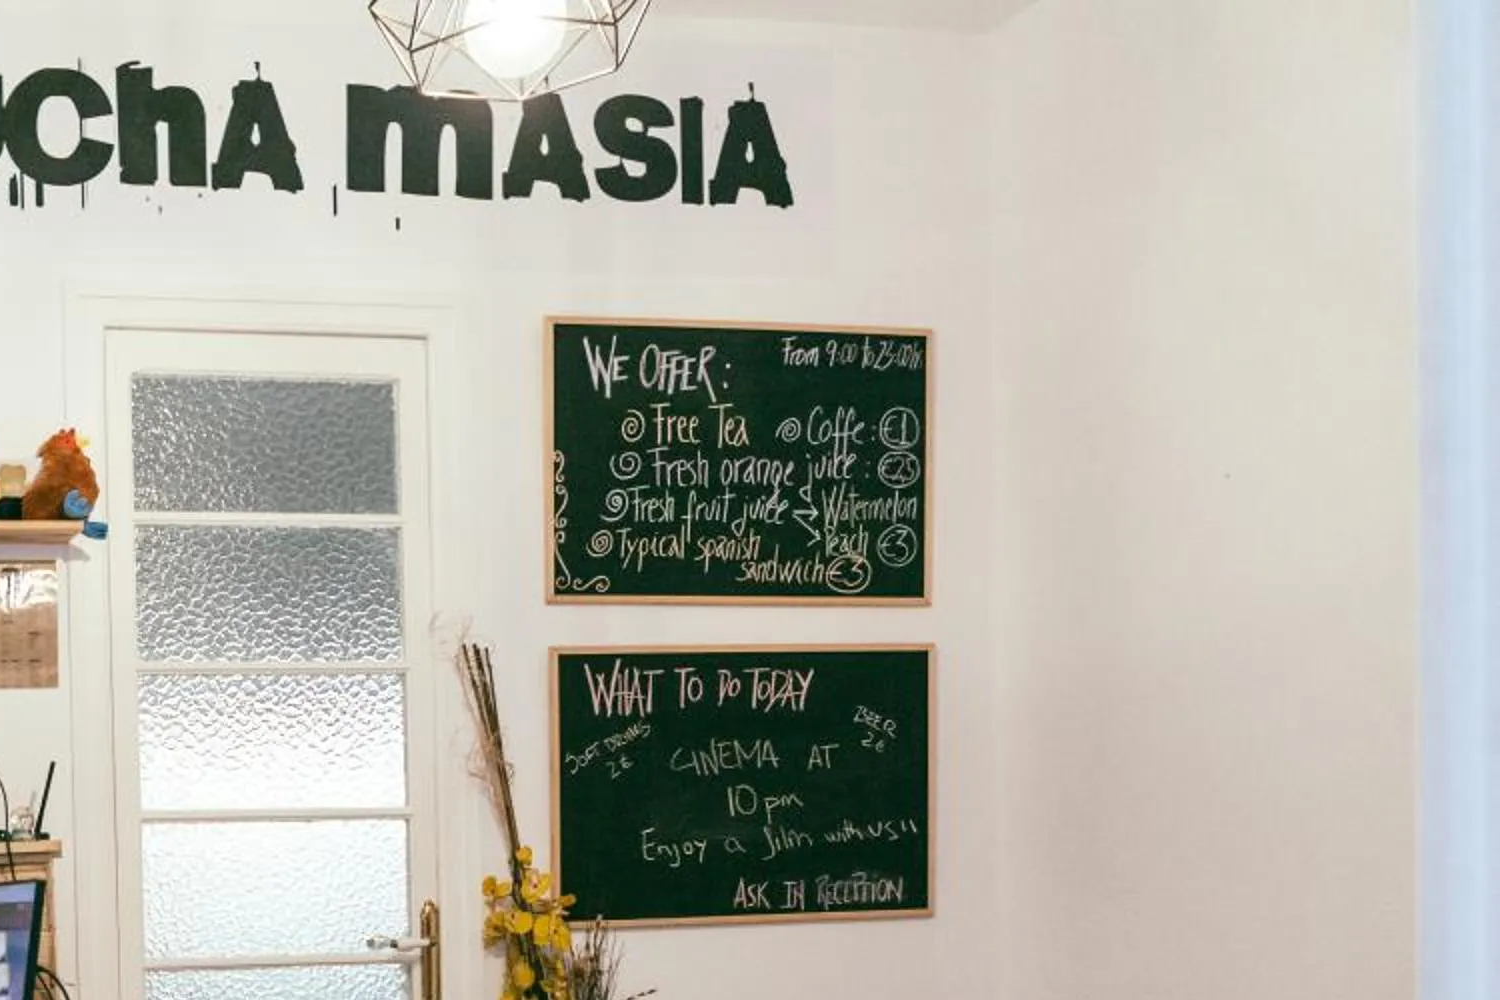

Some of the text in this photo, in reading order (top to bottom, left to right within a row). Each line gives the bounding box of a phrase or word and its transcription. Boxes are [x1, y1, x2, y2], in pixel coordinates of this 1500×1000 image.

[582, 335, 630, 399] WE
[781, 336, 819, 368] From
[650, 403, 749, 449] Free Tea
[646, 447, 710, 489] Fresh
[720, 455, 796, 507] orange
[626, 481, 917, 543] Fresh fruit juice Watermelon
[615, 524, 761, 575] Typical spanish
[735, 543, 826, 584] sandwich
[824, 524, 870, 560] Peach
[583, 658, 665, 717] WHAT
[669, 737, 840, 776] CINEMA AT
[727, 784, 804, 829] 10 pm
[641, 826, 708, 868] Enjoy
[724, 836, 746, 854] a
[733, 877, 767, 909] ASK
